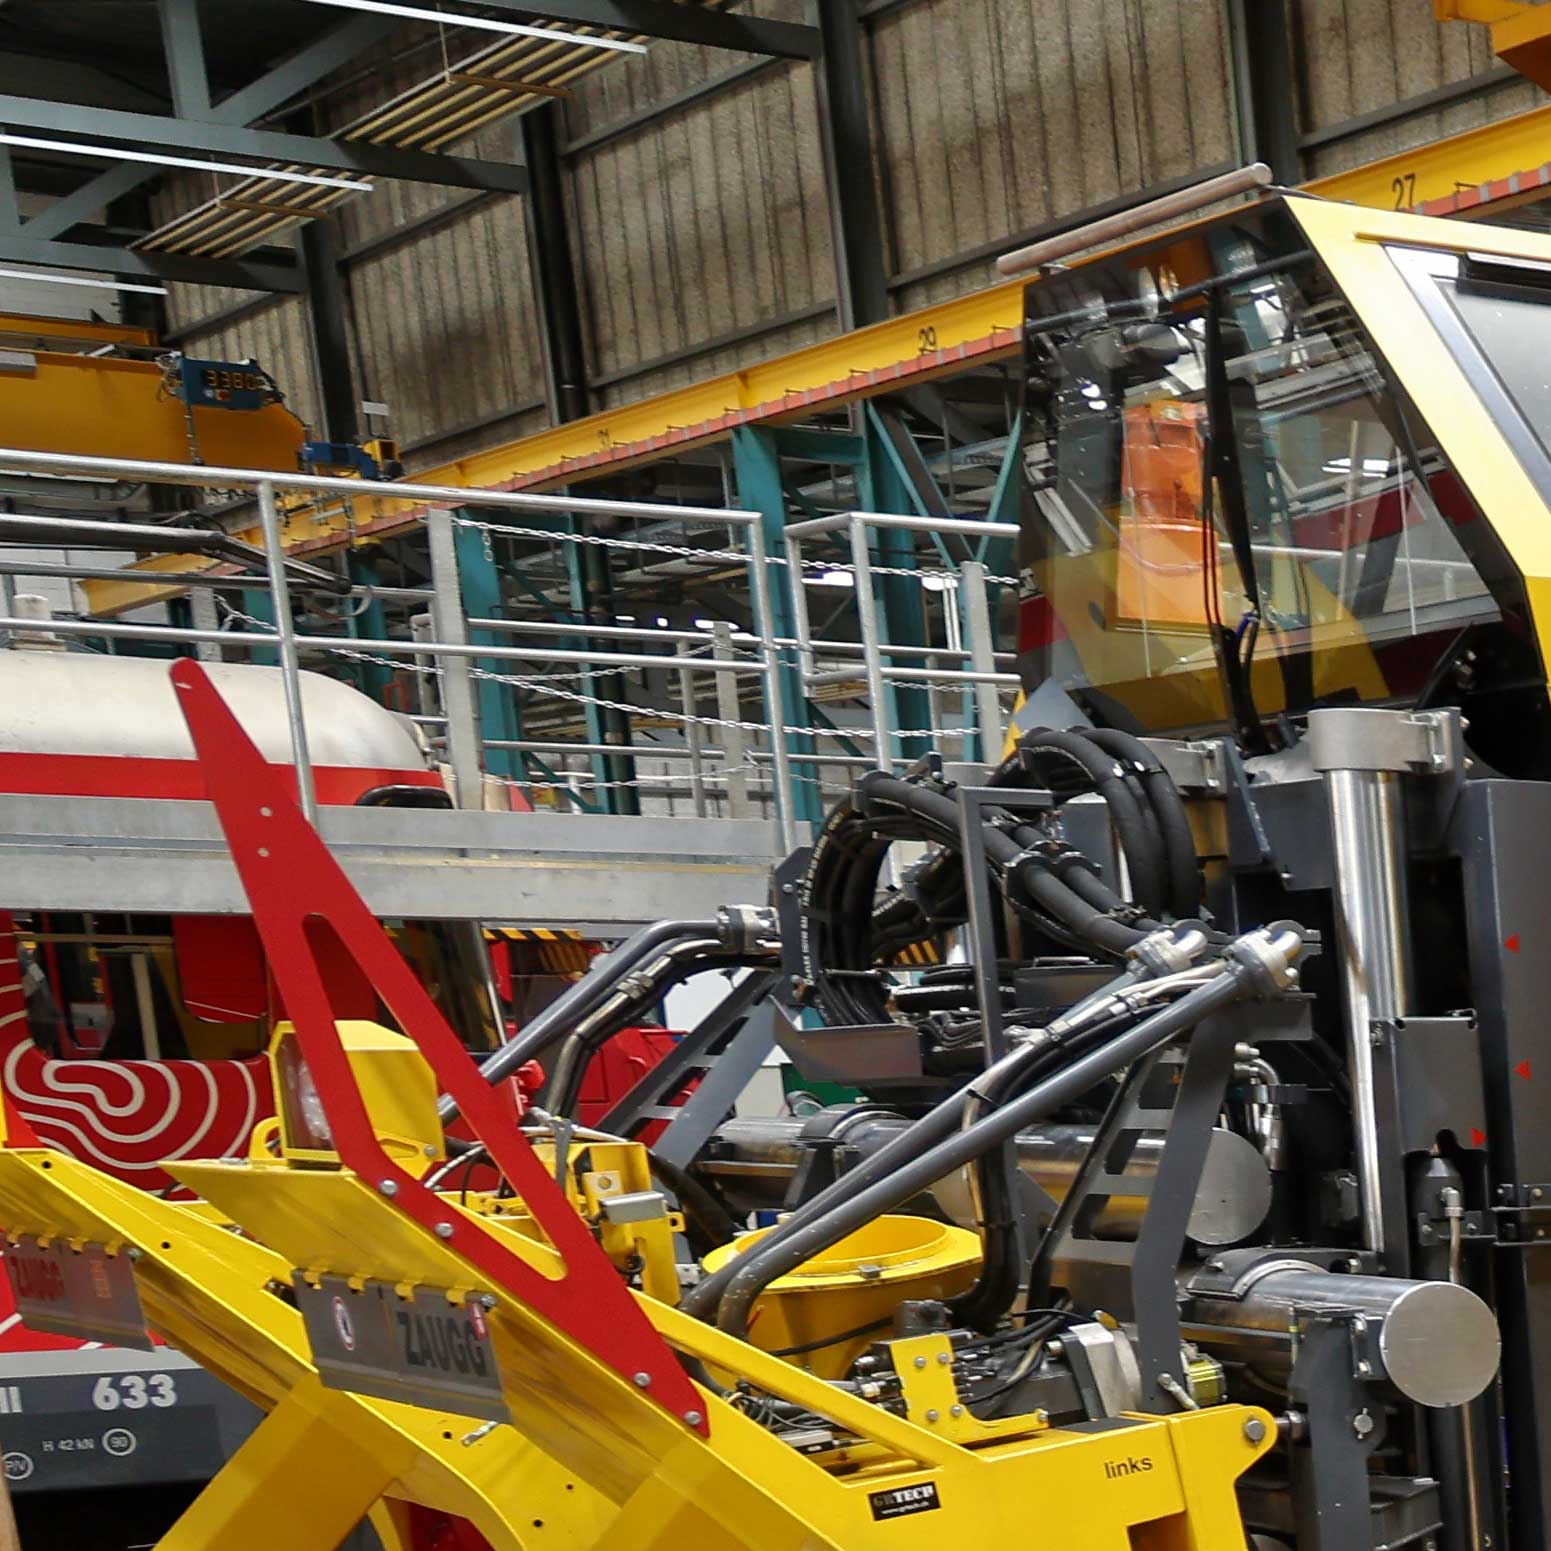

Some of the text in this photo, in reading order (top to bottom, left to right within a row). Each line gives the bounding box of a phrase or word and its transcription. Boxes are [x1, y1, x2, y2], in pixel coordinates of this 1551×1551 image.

[397, 1311, 489, 1377] ZAUGG
[92, 1373, 178, 1411] 633
[1103, 1455, 1154, 1480] links
